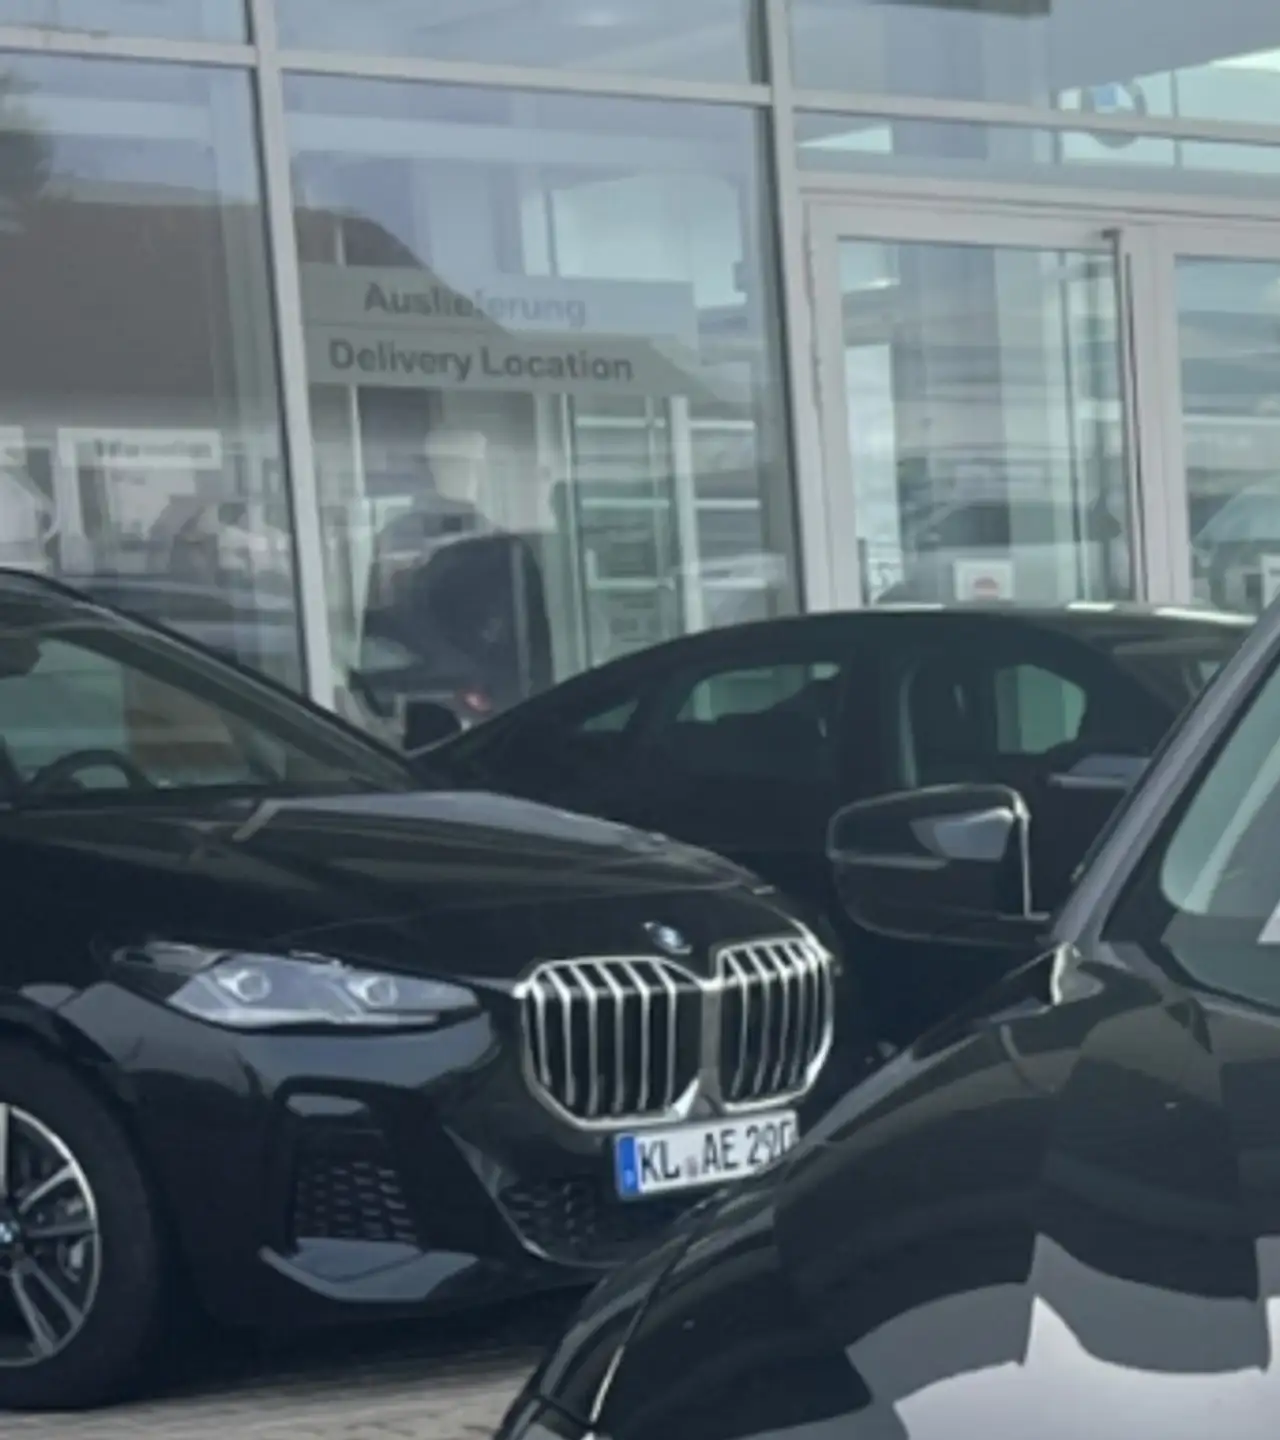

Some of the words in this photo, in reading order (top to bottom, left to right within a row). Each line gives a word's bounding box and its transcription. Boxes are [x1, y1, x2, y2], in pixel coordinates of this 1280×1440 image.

[363, 281, 587, 328] Auslieferung
[328, 337, 472, 382] Delivery
[480, 345, 635, 383] Location
[639, 1139, 682, 1184] KL
[702, 1128, 740, 1174] AE
